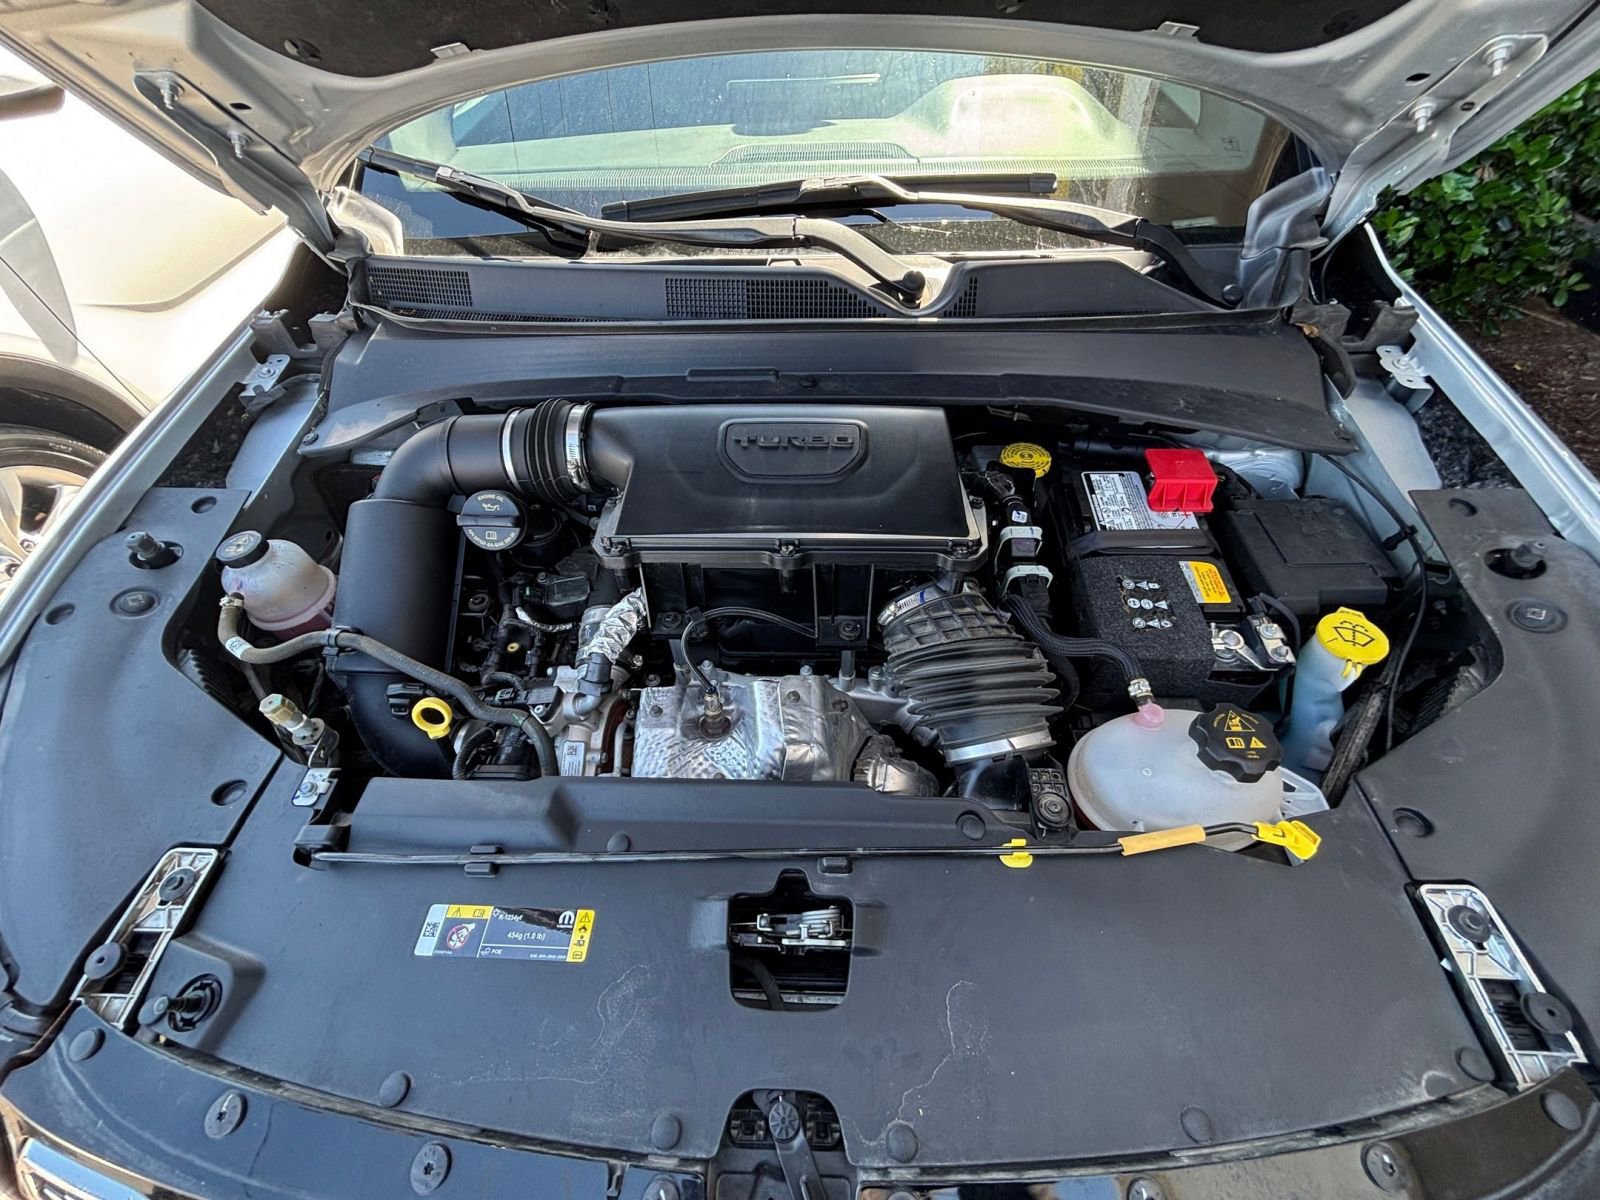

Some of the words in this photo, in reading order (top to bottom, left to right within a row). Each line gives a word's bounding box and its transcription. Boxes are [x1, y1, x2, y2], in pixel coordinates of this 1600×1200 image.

[732, 434, 855, 450] TURBO
[507, 931, 523, 940] 454g
[523, 931, 536, 940] (1.0
[536, 931, 546, 941] lb)
